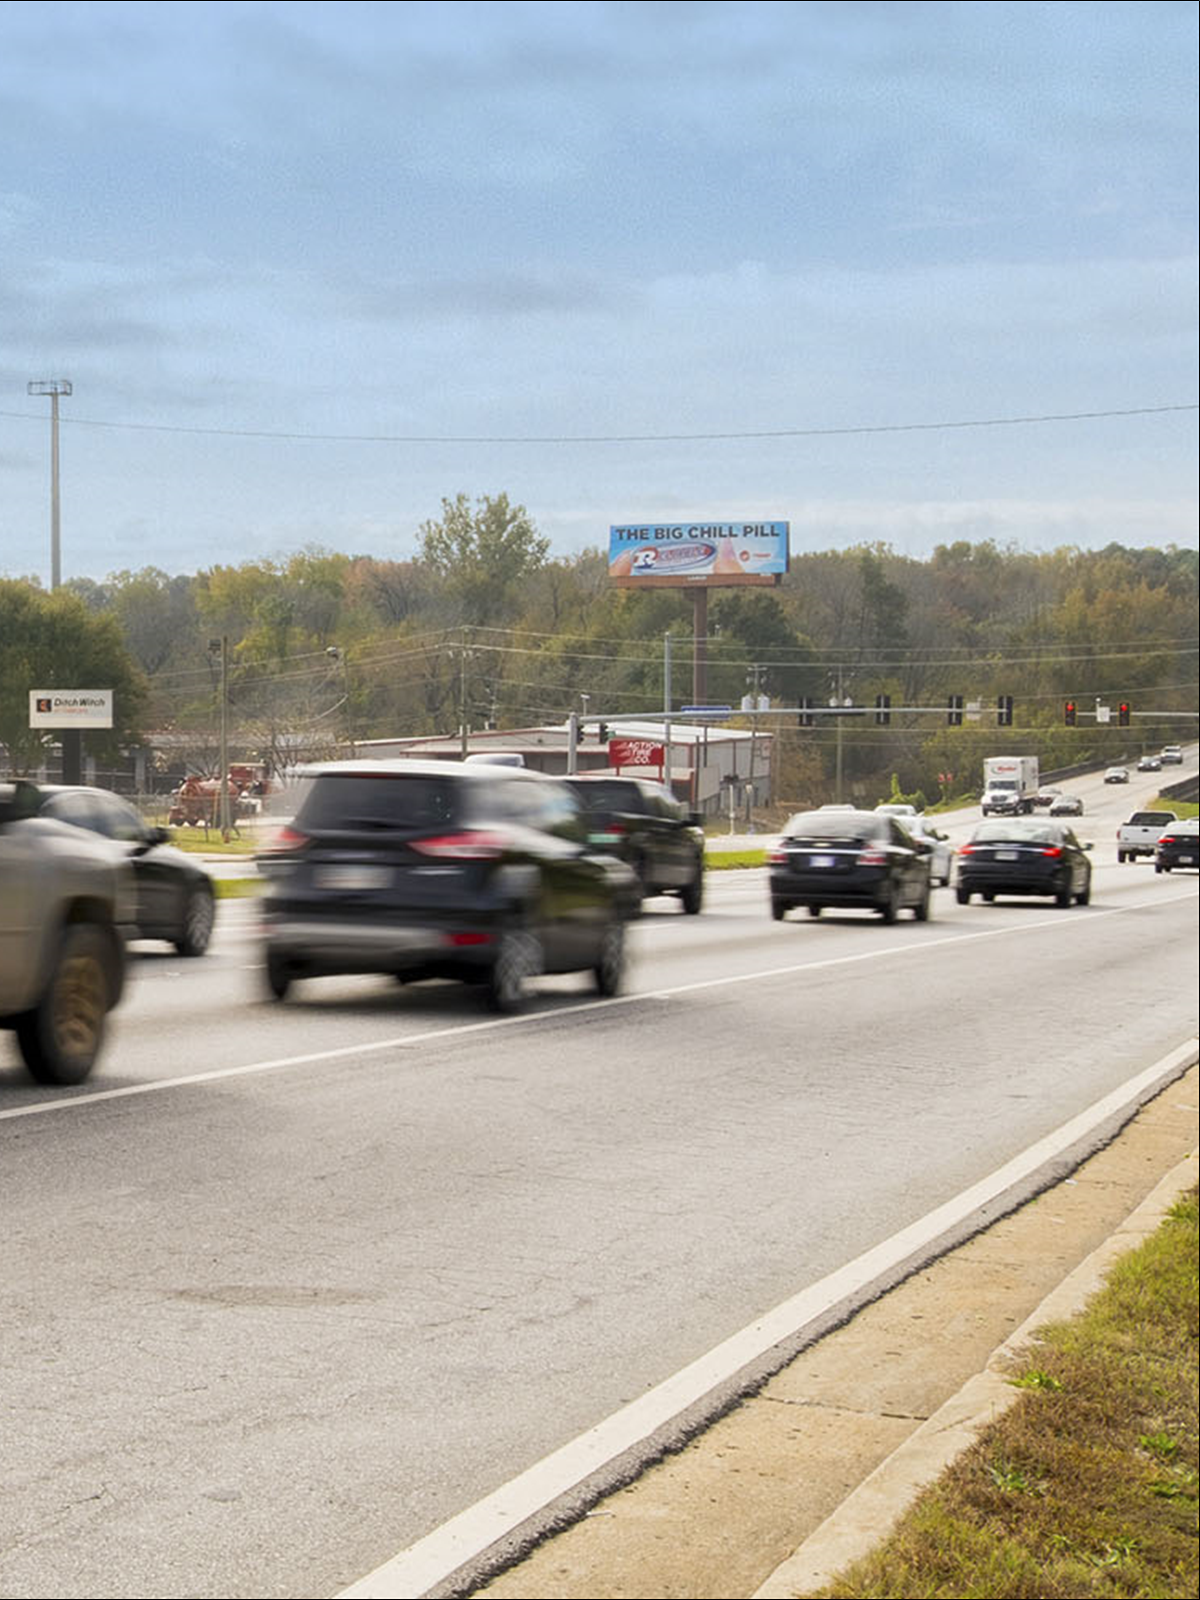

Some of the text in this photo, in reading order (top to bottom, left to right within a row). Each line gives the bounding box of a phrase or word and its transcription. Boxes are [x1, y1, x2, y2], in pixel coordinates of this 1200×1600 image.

[616, 525, 780, 541] THE BIG CHILL PILL
[628, 742, 662, 750] ACTION
